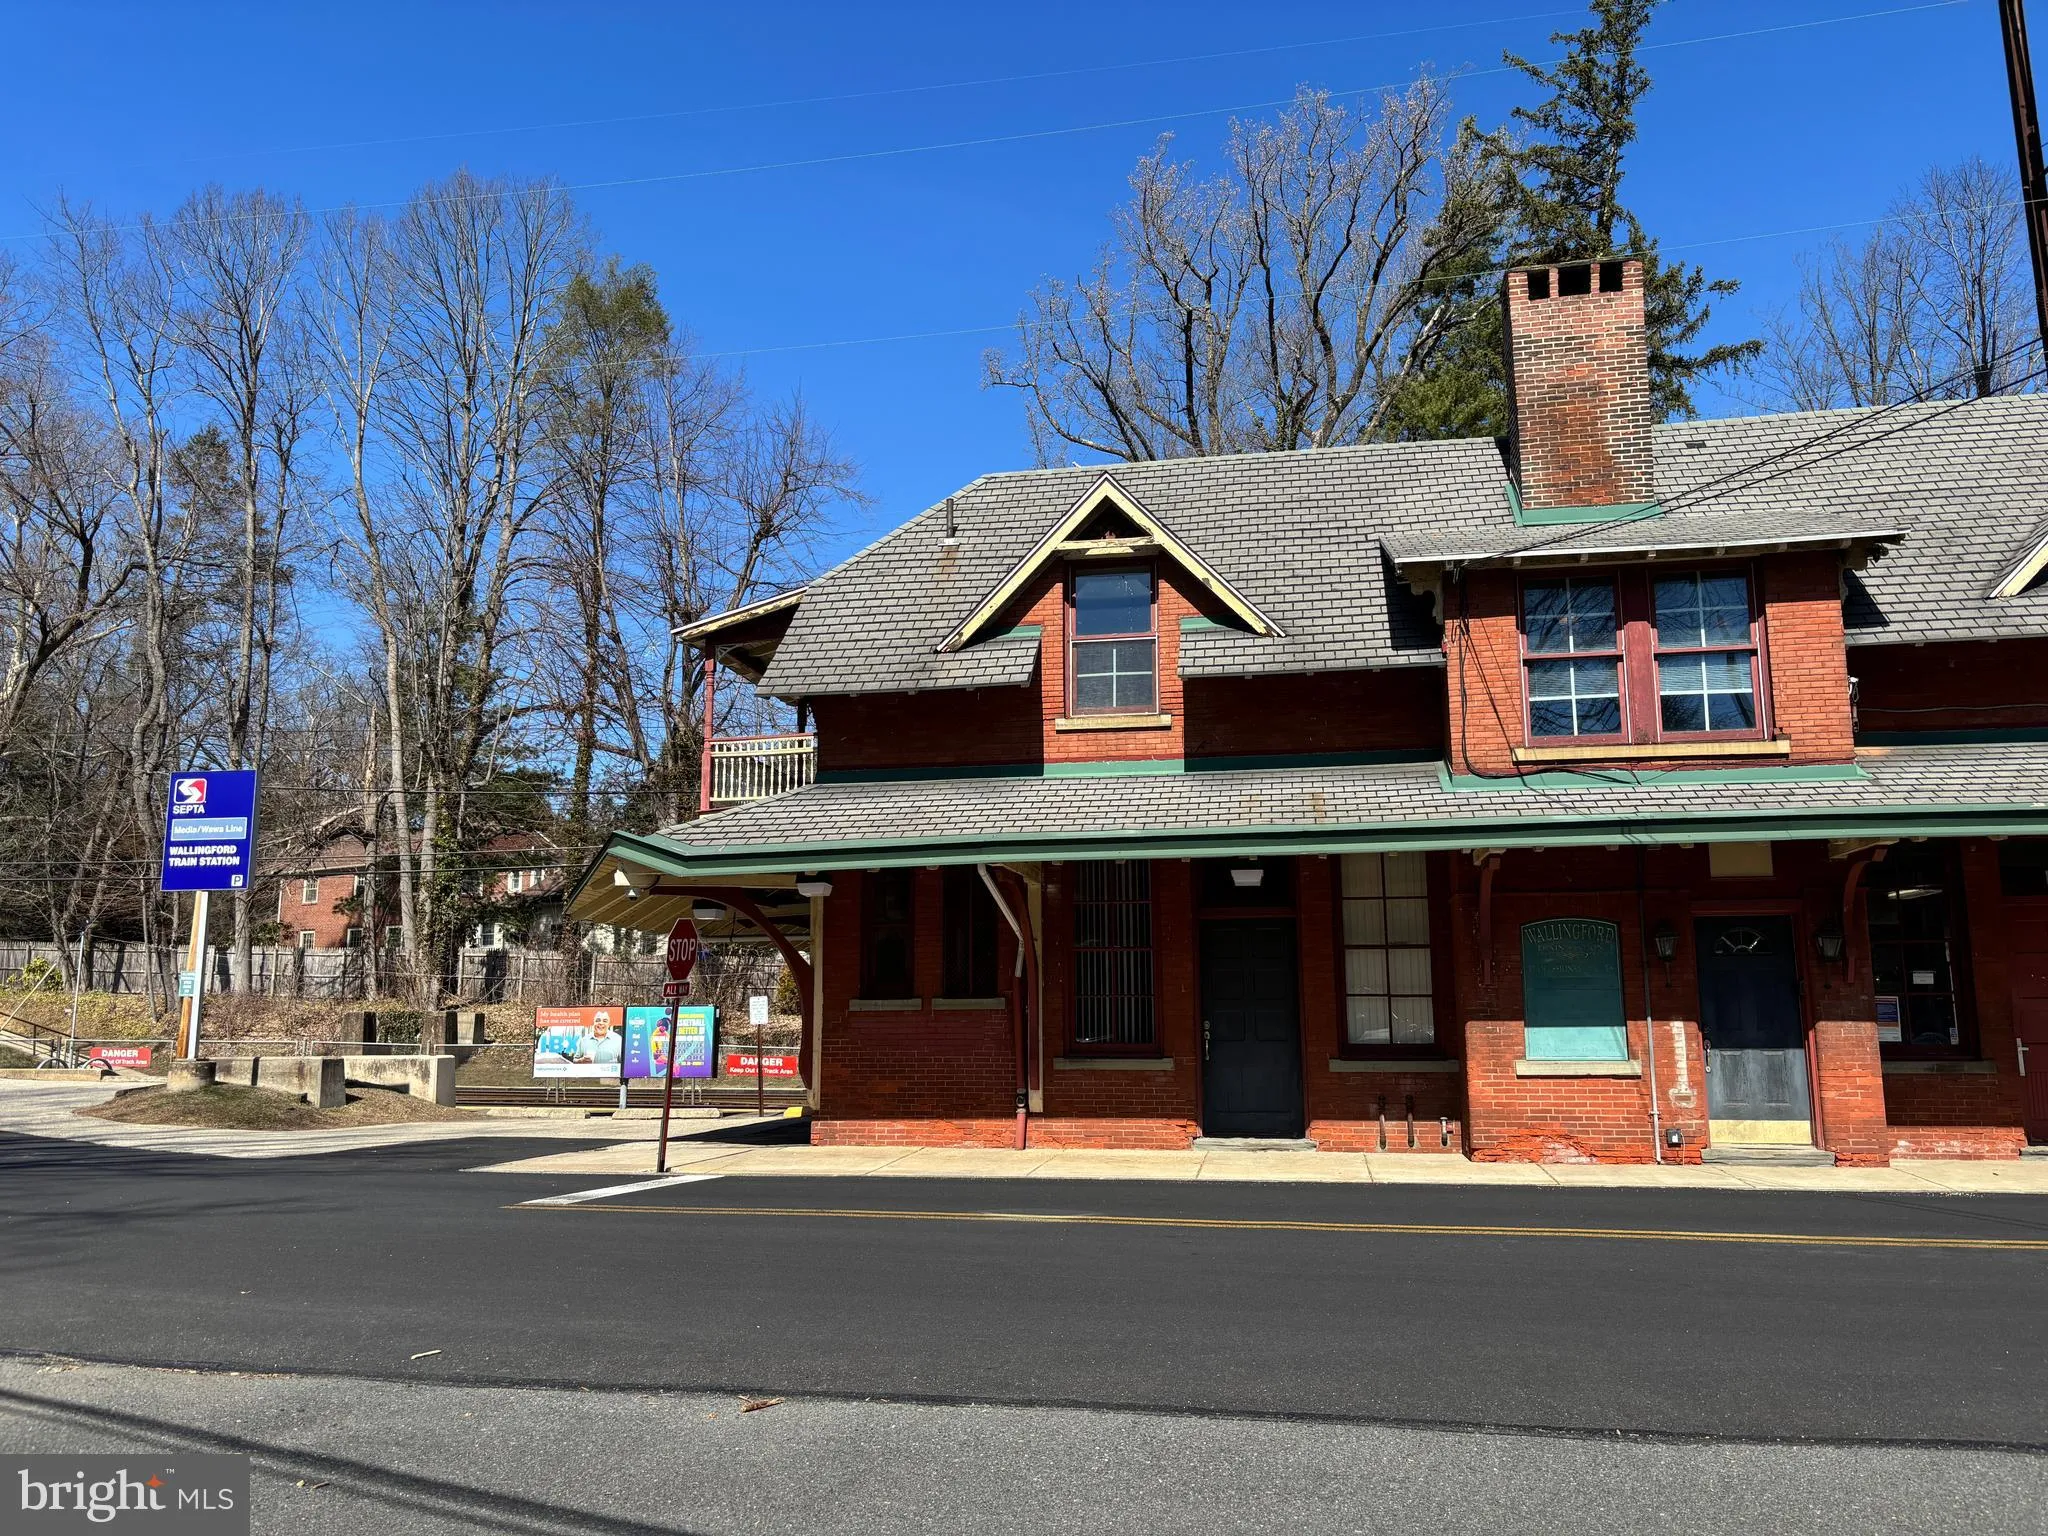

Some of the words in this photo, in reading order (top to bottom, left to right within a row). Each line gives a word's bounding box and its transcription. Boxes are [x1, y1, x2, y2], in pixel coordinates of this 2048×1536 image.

[173, 805, 205, 814] SEPTA
[226, 824, 243, 833] Line
[169, 845, 237, 855] WALLINGFORD
[169, 857, 197, 866] TRAIN
[199, 856, 240, 866] STATION
[233, 876, 242, 885] P
[1525, 923, 1614, 944] WALLINGFORD
[669, 938, 696, 962] STOP
[666, 985, 677, 995] ALL
[101, 1049, 139, 1058] DANGER
